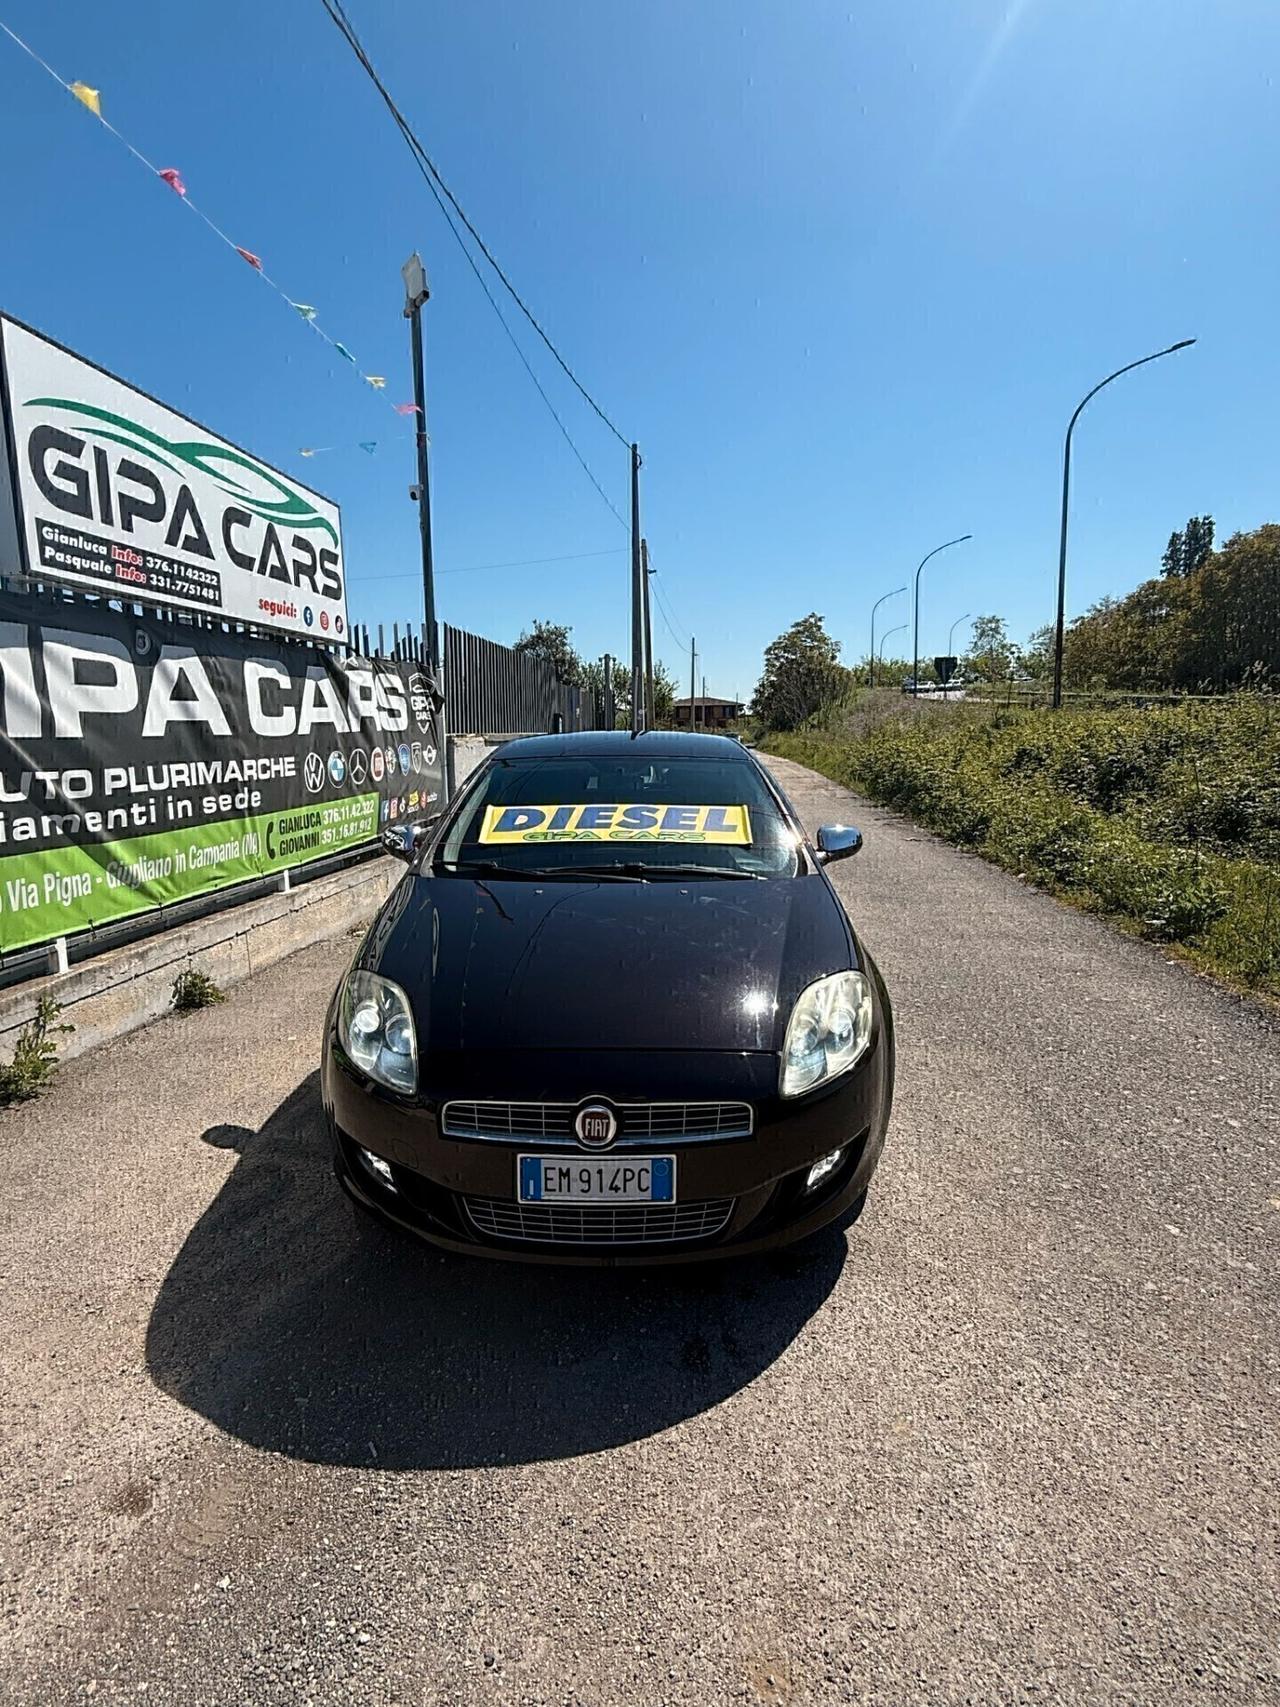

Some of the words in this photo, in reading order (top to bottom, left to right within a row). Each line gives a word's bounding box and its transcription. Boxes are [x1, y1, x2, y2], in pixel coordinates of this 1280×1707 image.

[28, 425, 215, 560] GIPA
[222, 506, 342, 600] CARS
[42, 526, 107, 555] Gianluca
[111, 544, 143, 567] Info:
[146, 556, 218, 586] 376.1142322
[44, 545, 112, 574] Pasquale
[115, 563, 147, 584] Info:
[150, 574, 219, 600] 331.7751481
[258, 598, 297, 618] seguici:
[244, 658, 408, 737] CARS
[104, 756, 296, 796] PLURIMARCHE
[167, 795, 193, 820] in
[203, 787, 262, 814] sede
[279, 811, 322, 835] GIANLUCA
[492, 805, 737, 833] DIESEL
[279, 832, 320, 857] GIOVANNI
[522, 830, 602, 842] GIPA
[609, 830, 706, 842] CARS
[6, 877, 39, 912] Via
[43, 871, 92, 907] Pigna
[175, 848, 187, 874] in
[189, 836, 240, 869] Campania
[584, 1118, 609, 1138] FIAT
[543, 1167, 571, 1193] EM
[579, 1167, 651, 1194] 914PC
